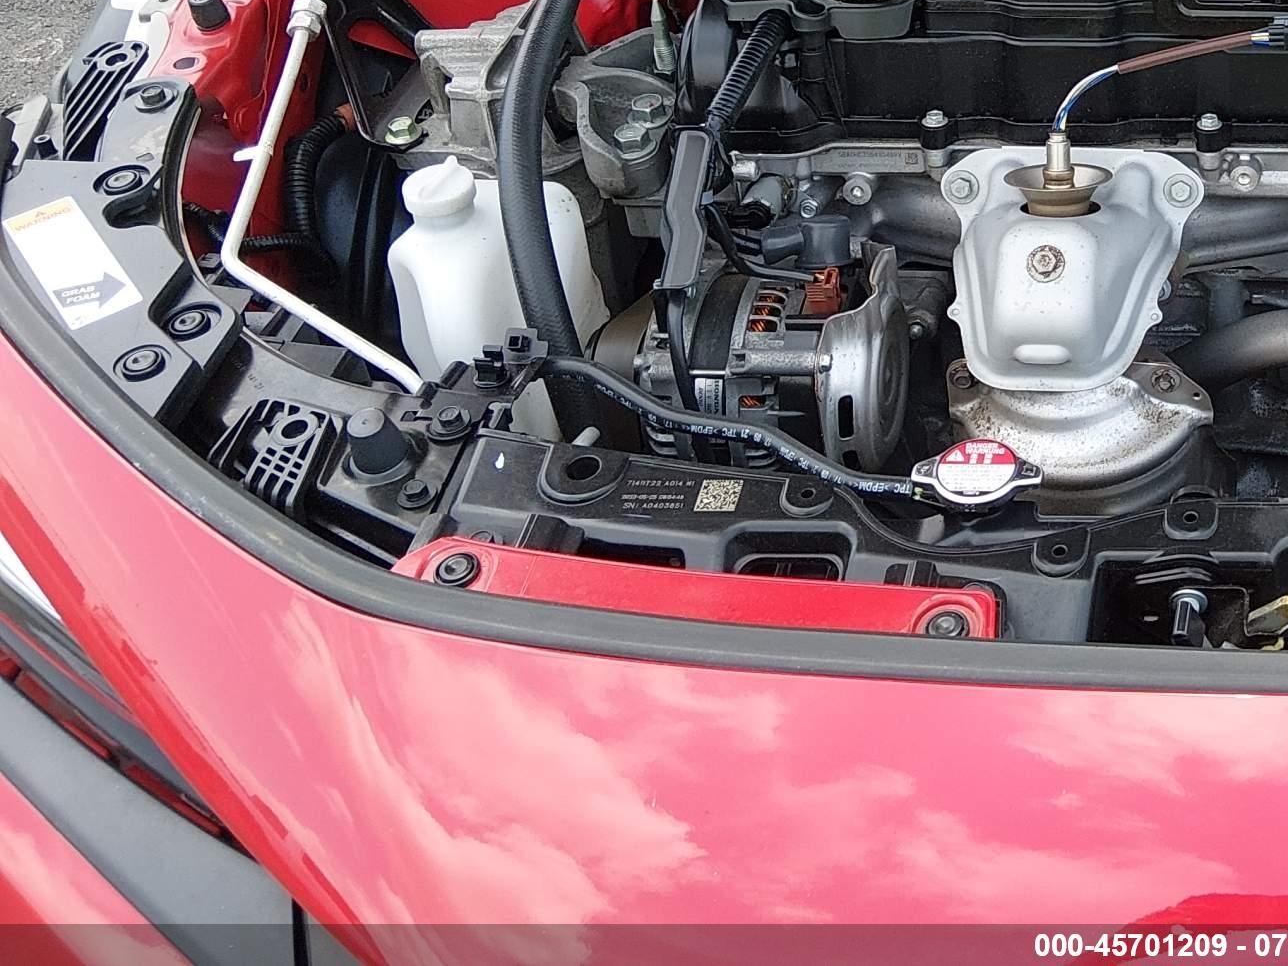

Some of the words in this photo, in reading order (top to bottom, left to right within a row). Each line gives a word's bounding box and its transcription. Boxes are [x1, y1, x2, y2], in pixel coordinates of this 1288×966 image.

[61, 285, 96, 297] GRAB
[66, 291, 100, 305] FOAM
[722, 427, 737, 438] TPC
